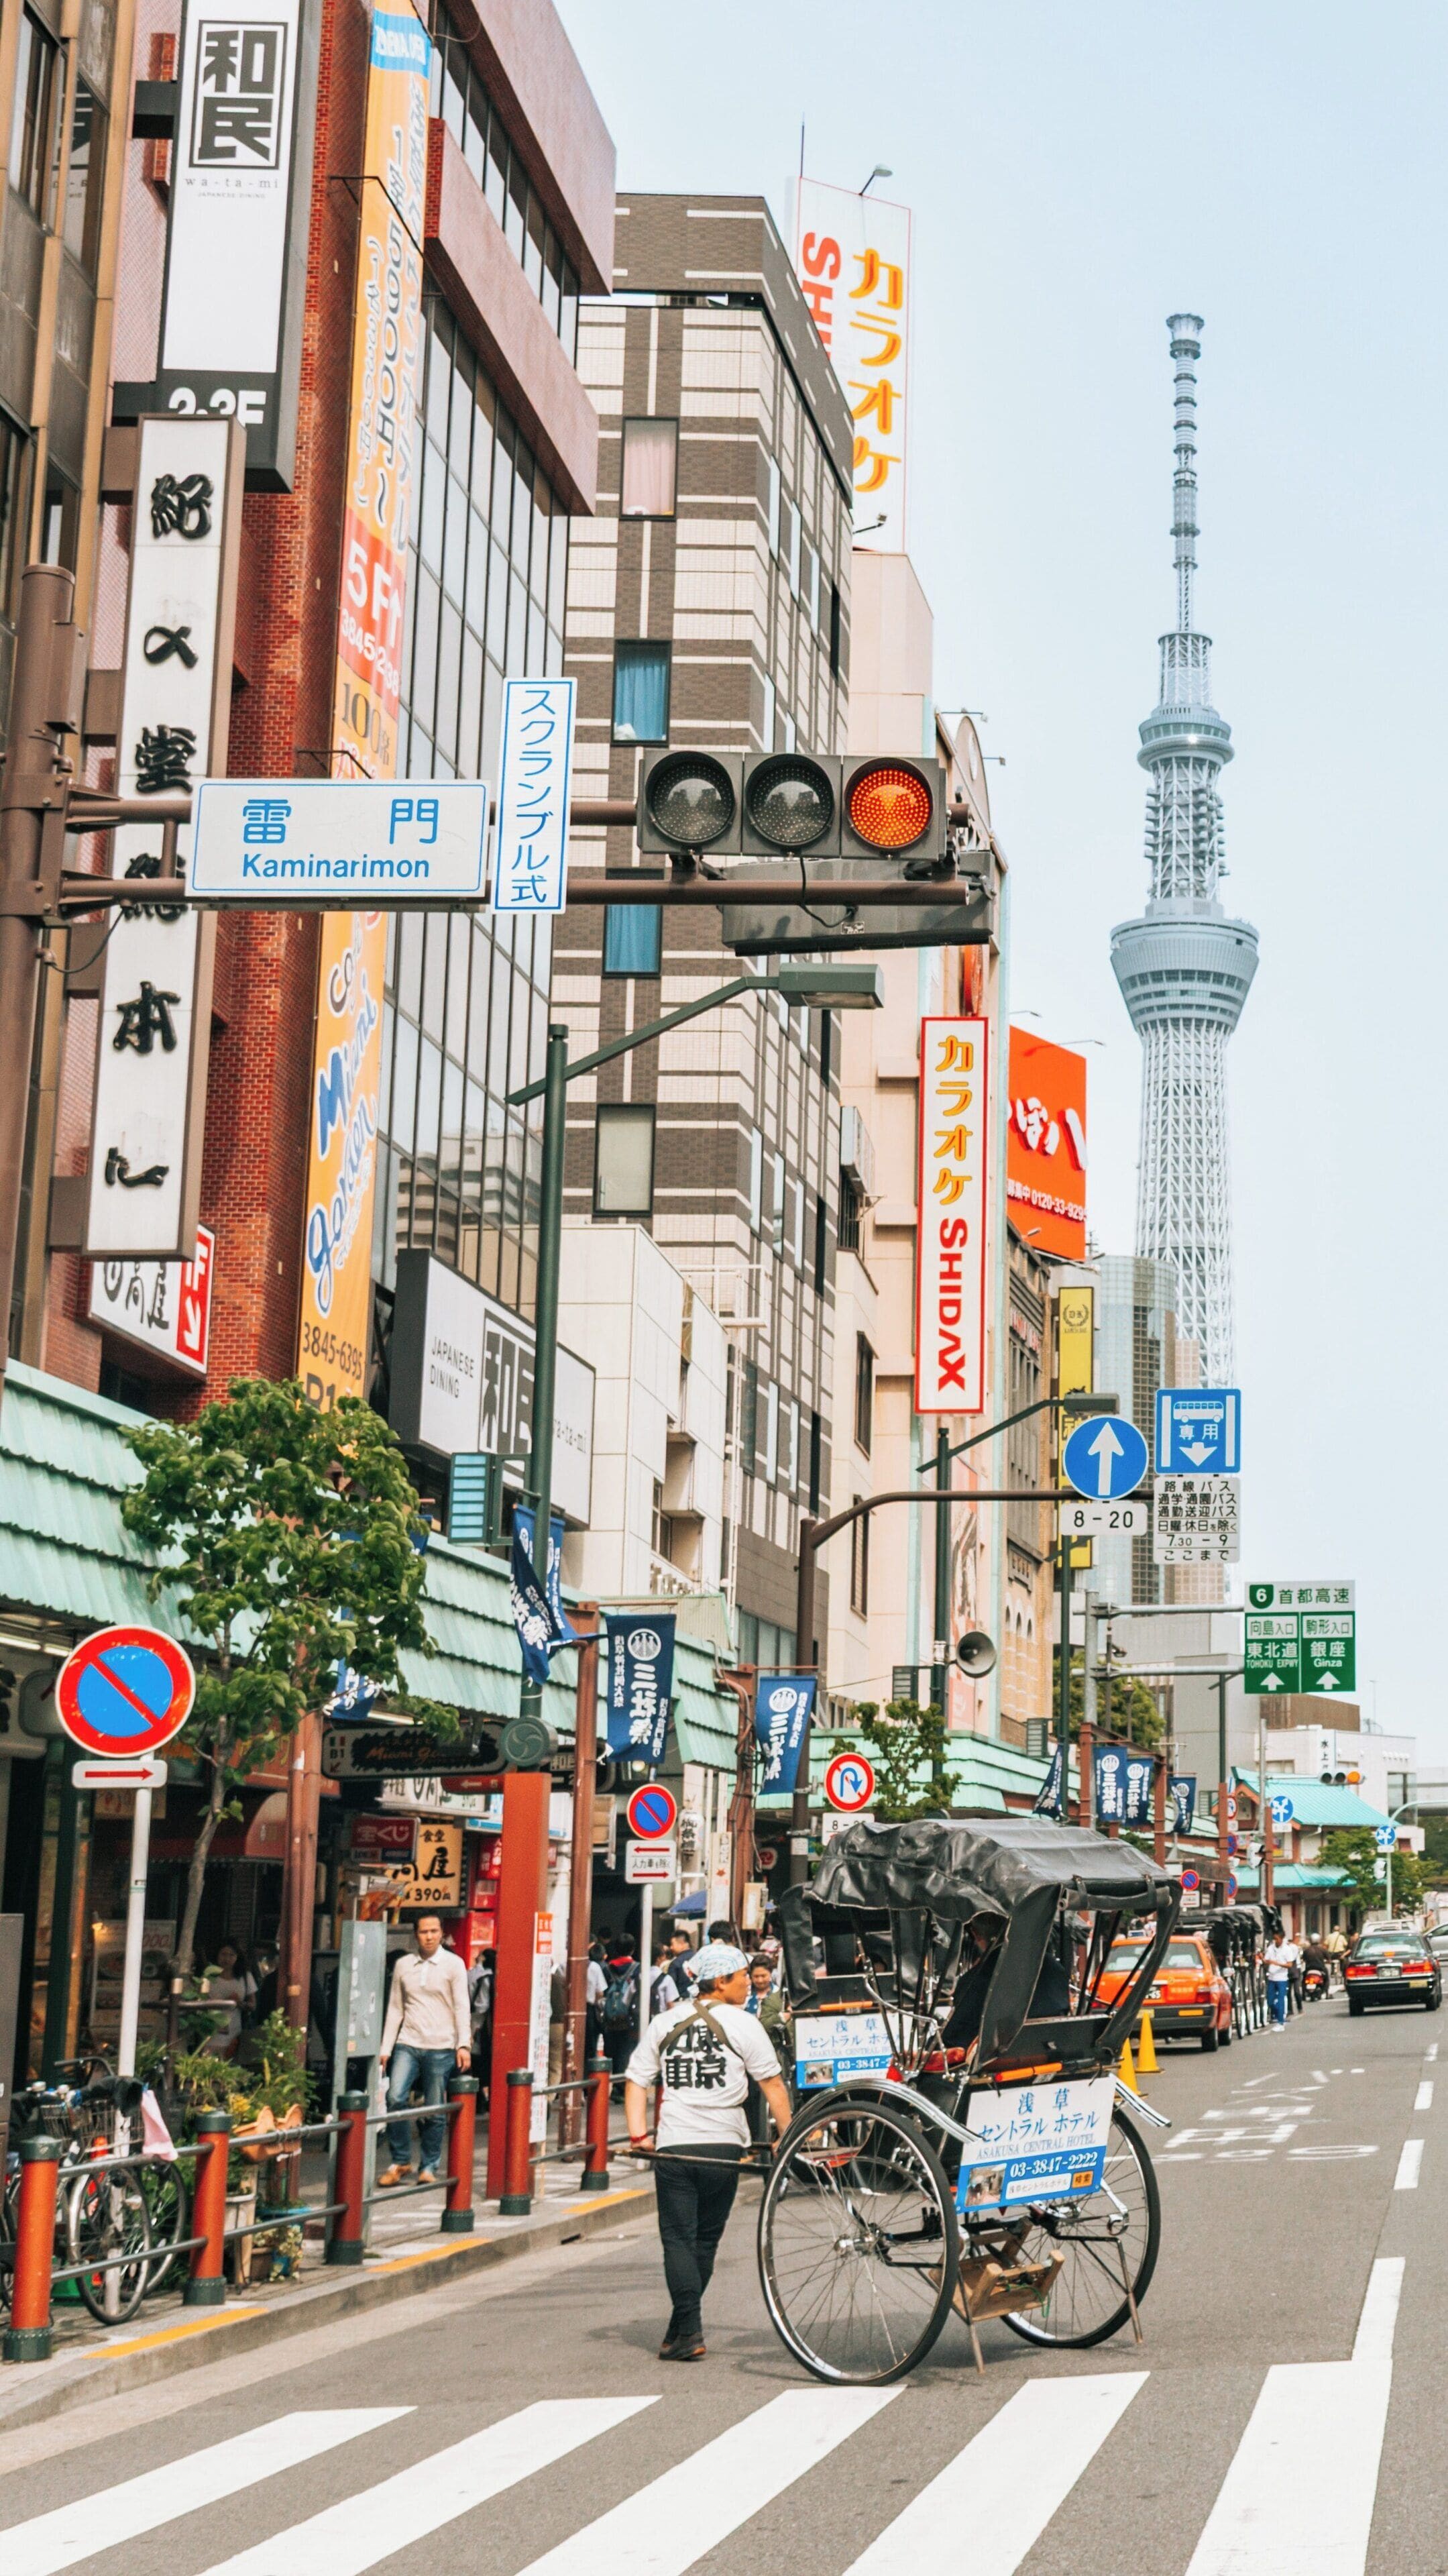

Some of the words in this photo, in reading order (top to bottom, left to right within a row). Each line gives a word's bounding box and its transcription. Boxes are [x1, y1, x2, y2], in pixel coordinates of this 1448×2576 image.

[198, 30, 279, 162] 和民
[848, 248, 903, 492] カラオケ
[511, 690, 557, 904] スクランブル式
[242, 798, 439, 845] 雷門
[243, 853, 430, 878] Kaminarimon
[934, 1035, 973, 1205] カラオケ
[938, 1218, 968, 1392] SHIDAX
[302, 1322, 363, 1381] 3845-6395
[431, 1336, 475, 1379] JAPANESE
[430, 1364, 460, 1399] DINING
[1178, 1424, 1219, 1440] 専用
[1164, 1481, 1231, 1492] 路線バス
[1158, 1505, 1237, 1517] 通勤送迎バス
[1164, 1550, 1229, 1561] ここまで
[1256, 1588, 1268, 1603] 6
[1278, 1588, 1350, 1604] 首都高速
[1250, 1620, 1294, 1635] 向島入口
[1306, 1619, 1350, 1635] 駒形入口
[1246, 1642, 1298, 1658] 東北道
[1310, 1641, 1346, 1658] 銀座
[1246, 1659, 1274, 1669] TOHOKU
[1276, 1658, 1299, 1668] EXPWY
[1313, 1658, 1343, 1668] Ginza
[629, 1662, 658, 1745] 三社祭
[1017, 2088, 1070, 2114] 浅草
[977, 2117, 1048, 2143] セントラル
[1053, 2111, 1101, 2134] ホテル
[976, 2145, 1020, 2161] ASAKUSA
[1023, 2140, 1064, 2153] CENTRAL
[1066, 2133, 1096, 2147] HOTEL
[1009, 2151, 1099, 2178] 03-3847-2222
